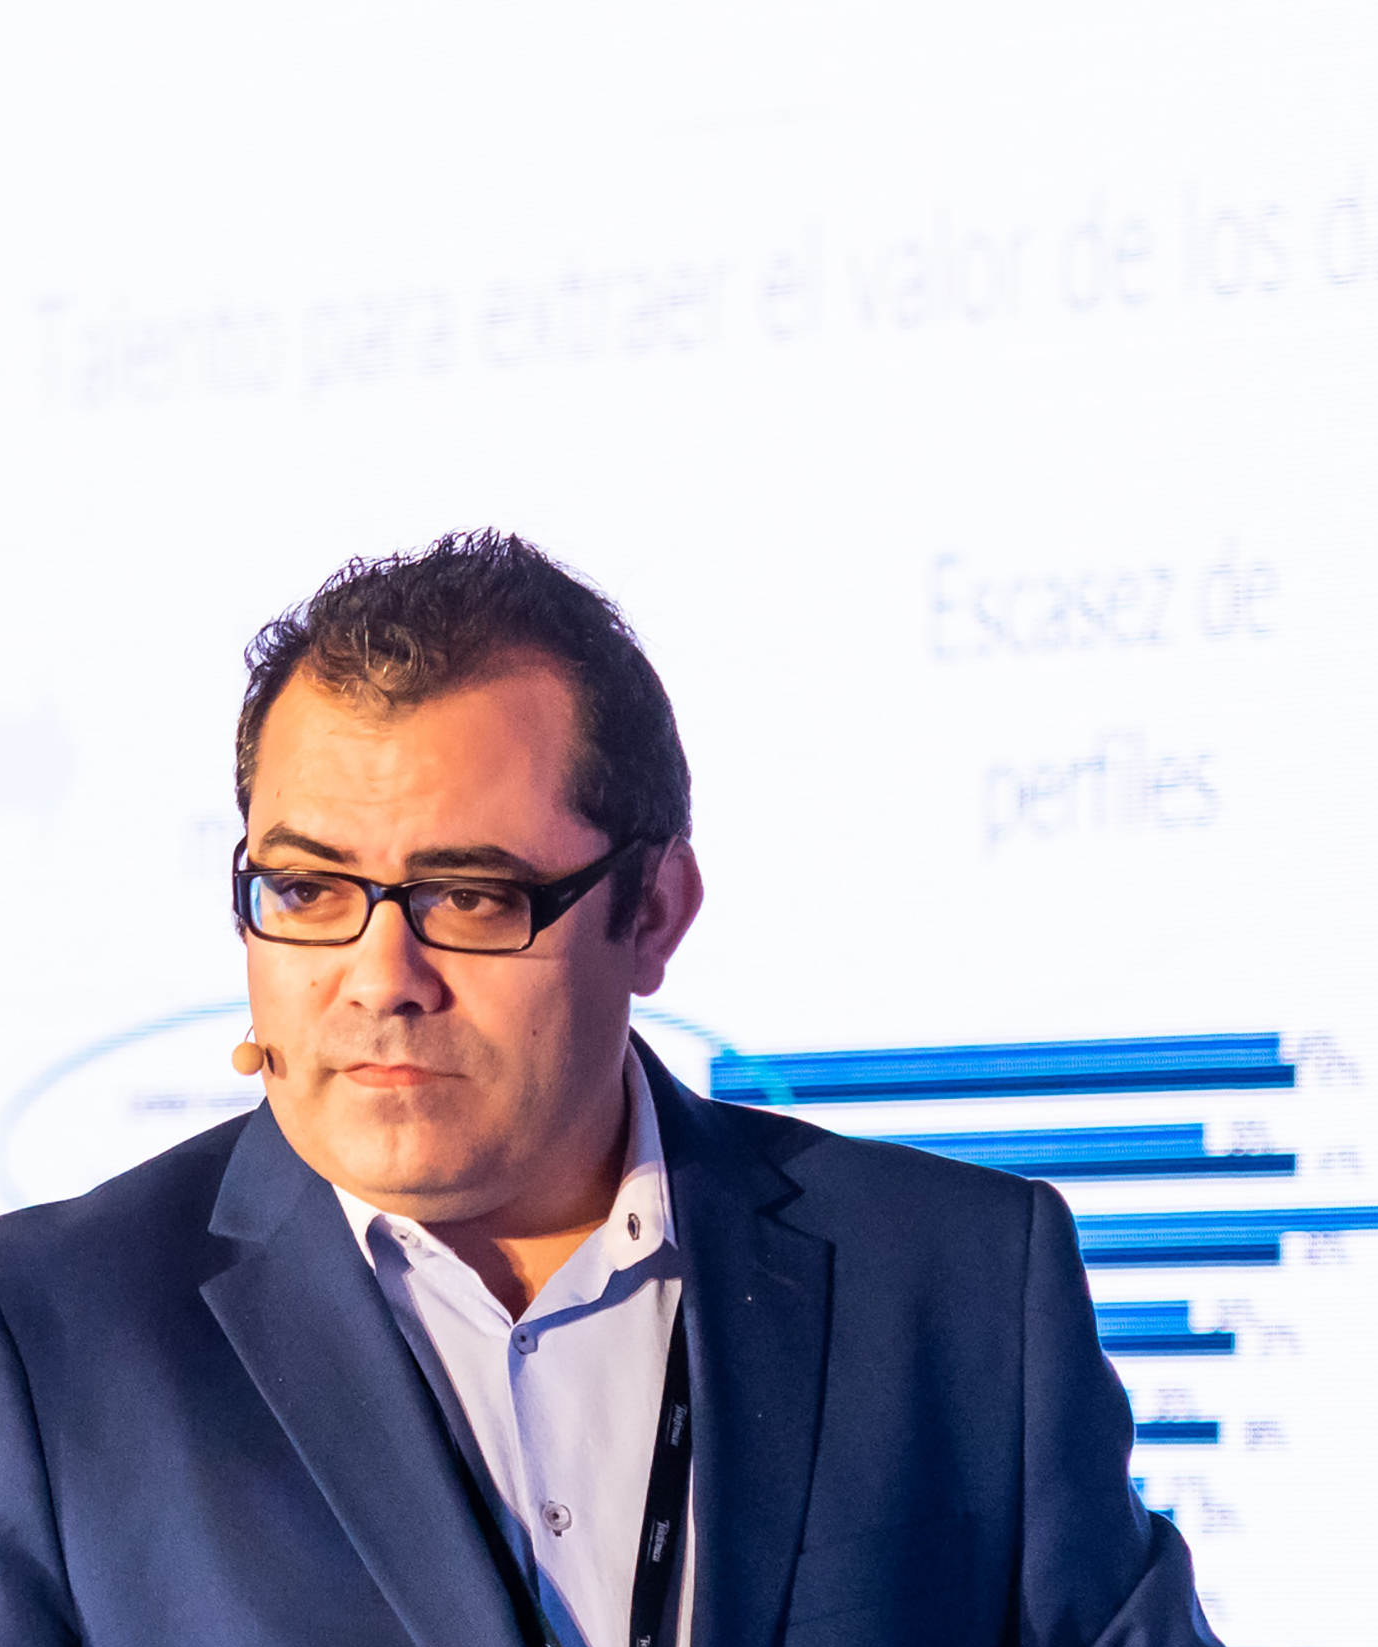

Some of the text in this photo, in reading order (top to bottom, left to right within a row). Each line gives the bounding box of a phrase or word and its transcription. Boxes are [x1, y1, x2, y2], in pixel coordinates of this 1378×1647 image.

[302, 276, 456, 412] para
[480, 246, 736, 372] extraer
[759, 213, 825, 344] el
[845, 203, 1031, 329] valor
[1058, 184, 1157, 315] de
[1181, 174, 1292, 300] los
[931, 532, 1280, 663] Escasez de
[982, 726, 1222, 861] perfiles
